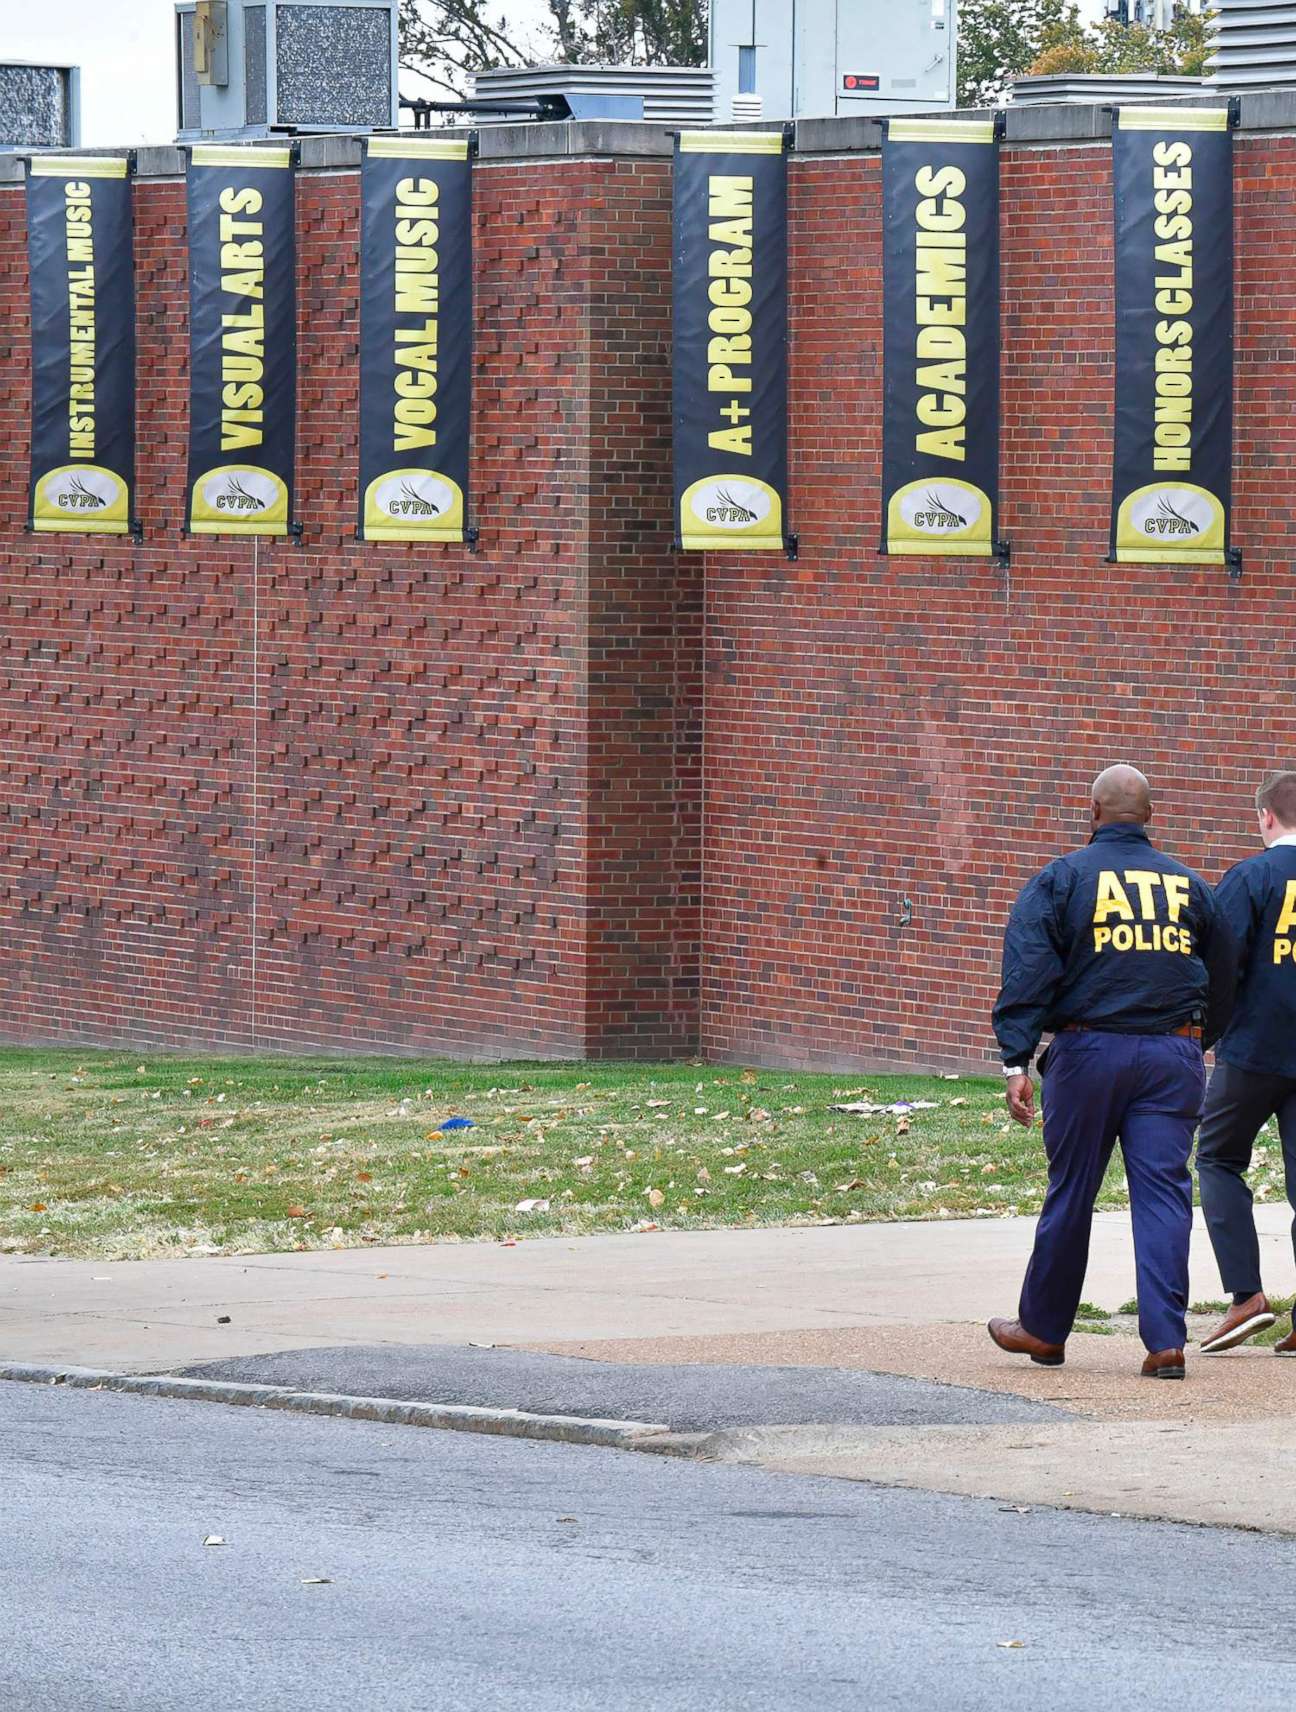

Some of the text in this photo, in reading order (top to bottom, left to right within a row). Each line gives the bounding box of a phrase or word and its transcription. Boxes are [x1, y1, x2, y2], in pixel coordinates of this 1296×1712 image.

[64, 181, 96, 459] INSTRUMENTAL MUSIC
[218, 186, 265, 452] VISUAL ARTS
[393, 177, 439, 452] VOCAL MUSIC
[707, 175, 753, 456] A+ PROGRAM
[915, 165, 967, 462] ACADEMICS
[1153, 141, 1193, 471] HONORS CLASSES
[58, 494, 100, 508] CVPA
[216, 495, 257, 509] CVPA
[389, 500, 432, 515] CVPA
[706, 507, 750, 522] CVPA
[914, 512, 960, 527] CVPA
[1144, 518, 1191, 534] CVPA
[1093, 870, 1191, 923] ATF
[1093, 924, 1193, 955] POLICE
